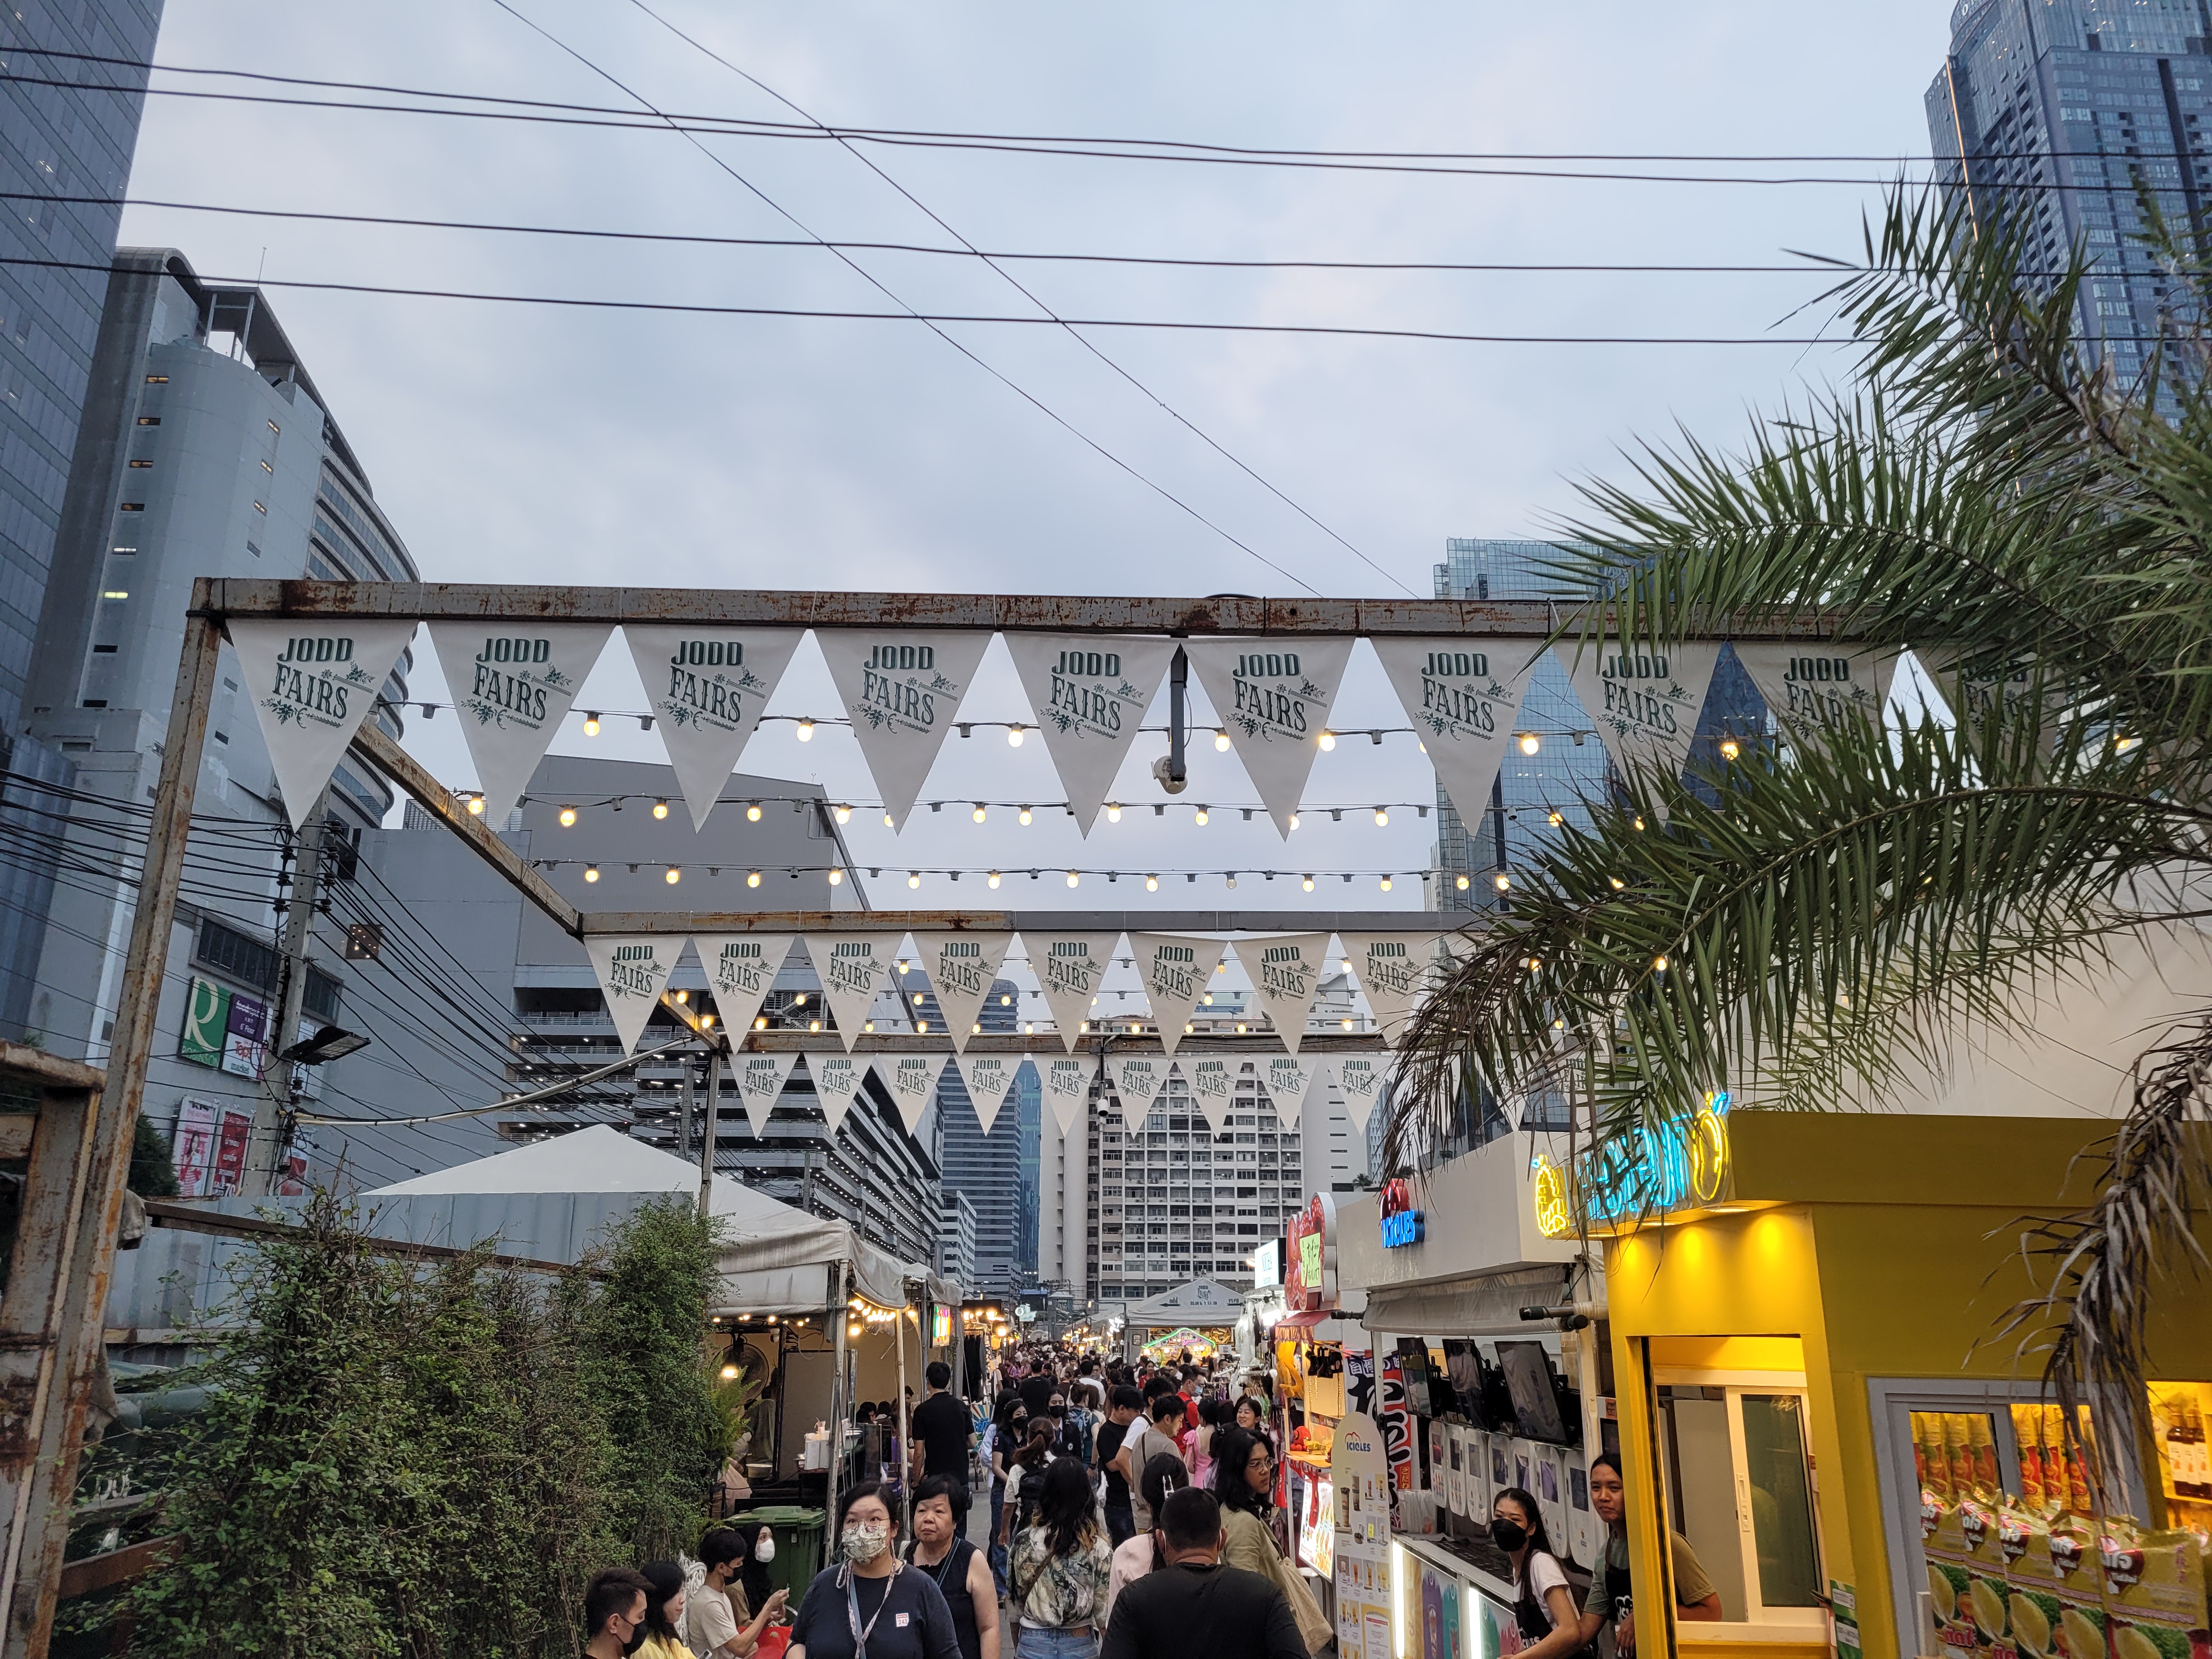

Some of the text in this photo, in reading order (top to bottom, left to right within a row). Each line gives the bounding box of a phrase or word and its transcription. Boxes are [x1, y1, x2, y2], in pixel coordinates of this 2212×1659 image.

[277, 637, 354, 662] JODD
[476, 639, 550, 662] JODD
[670, 640, 743, 665] JODD
[864, 646, 934, 669] JODD
[1052, 651, 1121, 676] JODD
[1232, 653, 1301, 677] JODD
[1421, 652, 1488, 676] JODD
[1602, 656, 1669, 679] JODD
[1784, 658, 1849, 681] JODD
[273, 662, 348, 719] FAIRS
[473, 662, 547, 721] FAIRS
[668, 665, 741, 723] FAIRS
[862, 669, 934, 725] FAIRS
[1049, 675, 1121, 731] FAIRS
[1234, 678, 1307, 732] FAIRS
[1421, 676, 1495, 732] FAIRS
[1602, 679, 1677, 733] FAIRS
[1784, 681, 1850, 732] FAR
[612, 945, 653, 961] JODD
[720, 943, 761, 958] JODD
[831, 943, 871, 957] JODD
[940, 942, 980, 957] JODD
[1048, 942, 1088, 957] JODD
[1154, 945, 1194, 962] JODD
[1262, 946, 1300, 963] JODD
[1367, 943, 1406, 957] JODD
[611, 961, 652, 993] FAIRS
[719, 958, 760, 991] FAIRS
[830, 957, 871, 990] FAIRS
[939, 957, 981, 991] FAIRS
[1048, 957, 1089, 990] FAIRS
[1153, 960, 1193, 996] FAIRS
[1261, 964, 1305, 995] FAIRS
[1367, 957, 1409, 991] FAIRS
[746, 1059, 775, 1070] JODD
[823, 1059, 851, 1070] JODD
[898, 1059, 926, 1070] JODD
[973, 1060, 1001, 1070] JODD
[1051, 1060, 1079, 1071] JODD
[1124, 1061, 1151, 1073] JODD
[1195, 1061, 1223, 1073] JODD
[1269, 1059, 1297, 1069] JODD
[1342, 1060, 1370, 1071] JODD
[746, 1071, 774, 1093] FAIRS
[822, 1070, 850, 1092] FAIRS
[898, 1070, 926, 1093] FAIRS
[972, 1070, 1001, 1092] FAIRS
[1051, 1071, 1079, 1094] FAIRS
[1122, 1071, 1150, 1096] FAIRS
[1196, 1073, 1226, 1094] FAIRS
[1271, 1069, 1299, 1091] FAIRS
[1342, 1071, 1372, 1093] FAIRS
[1346, 1442, 1371, 1452] ICICLES
